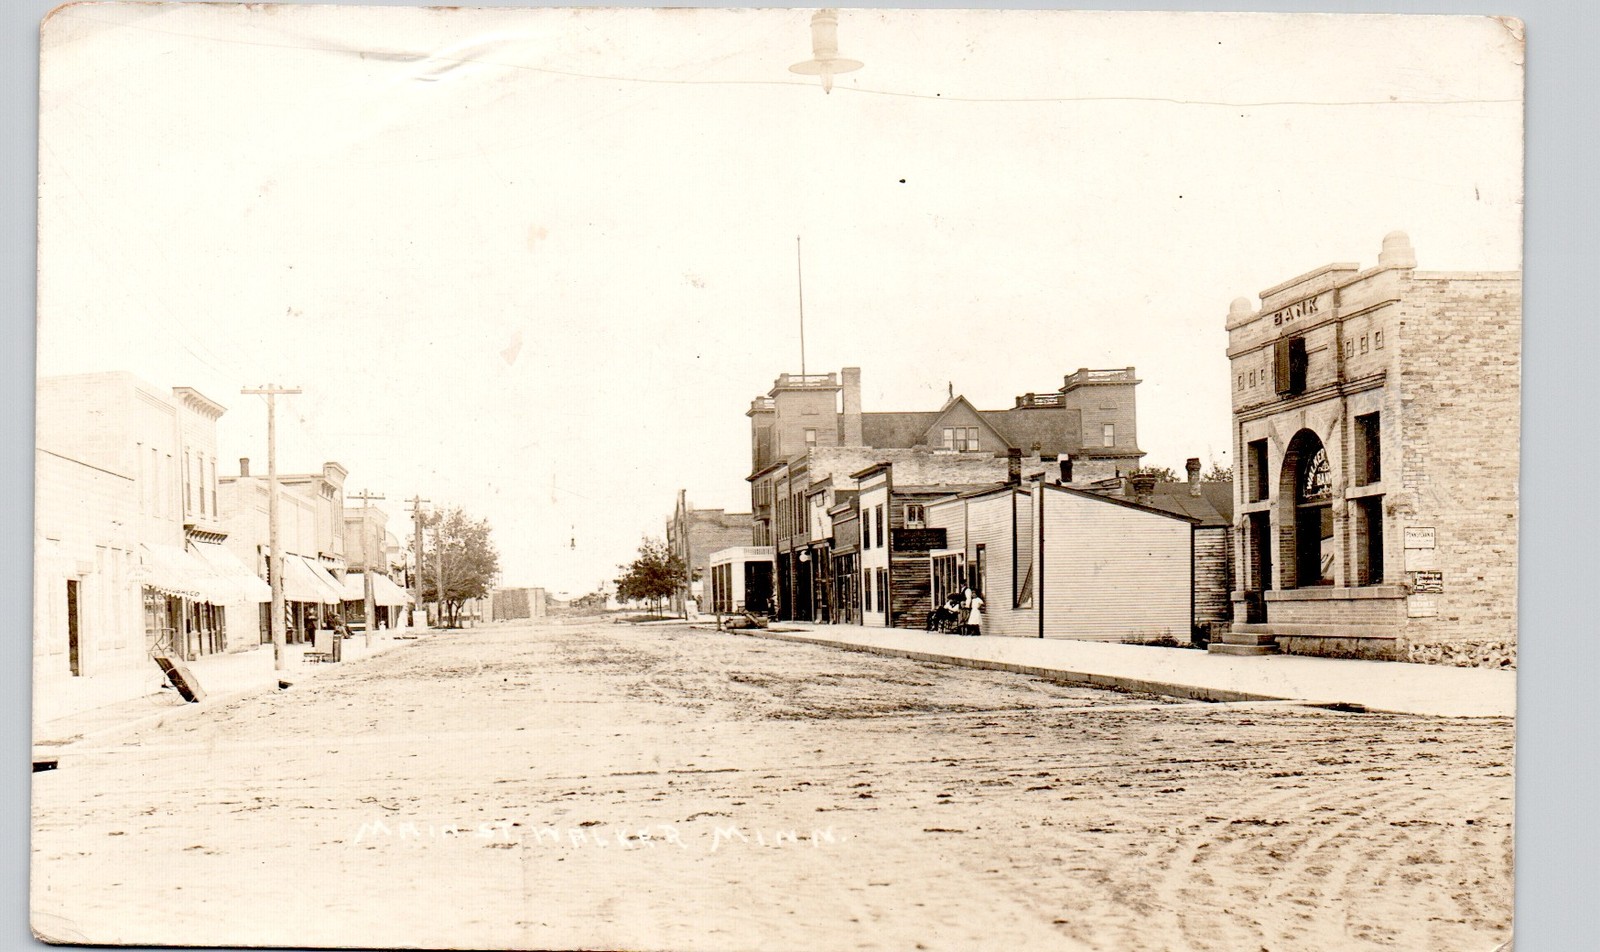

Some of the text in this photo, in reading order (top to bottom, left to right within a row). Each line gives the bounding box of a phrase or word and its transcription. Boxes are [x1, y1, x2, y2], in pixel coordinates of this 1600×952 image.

[1274, 297, 1319, 326] BANK
[1306, 448, 1327, 490] WALKER
[1316, 472, 1331, 486] BAN
